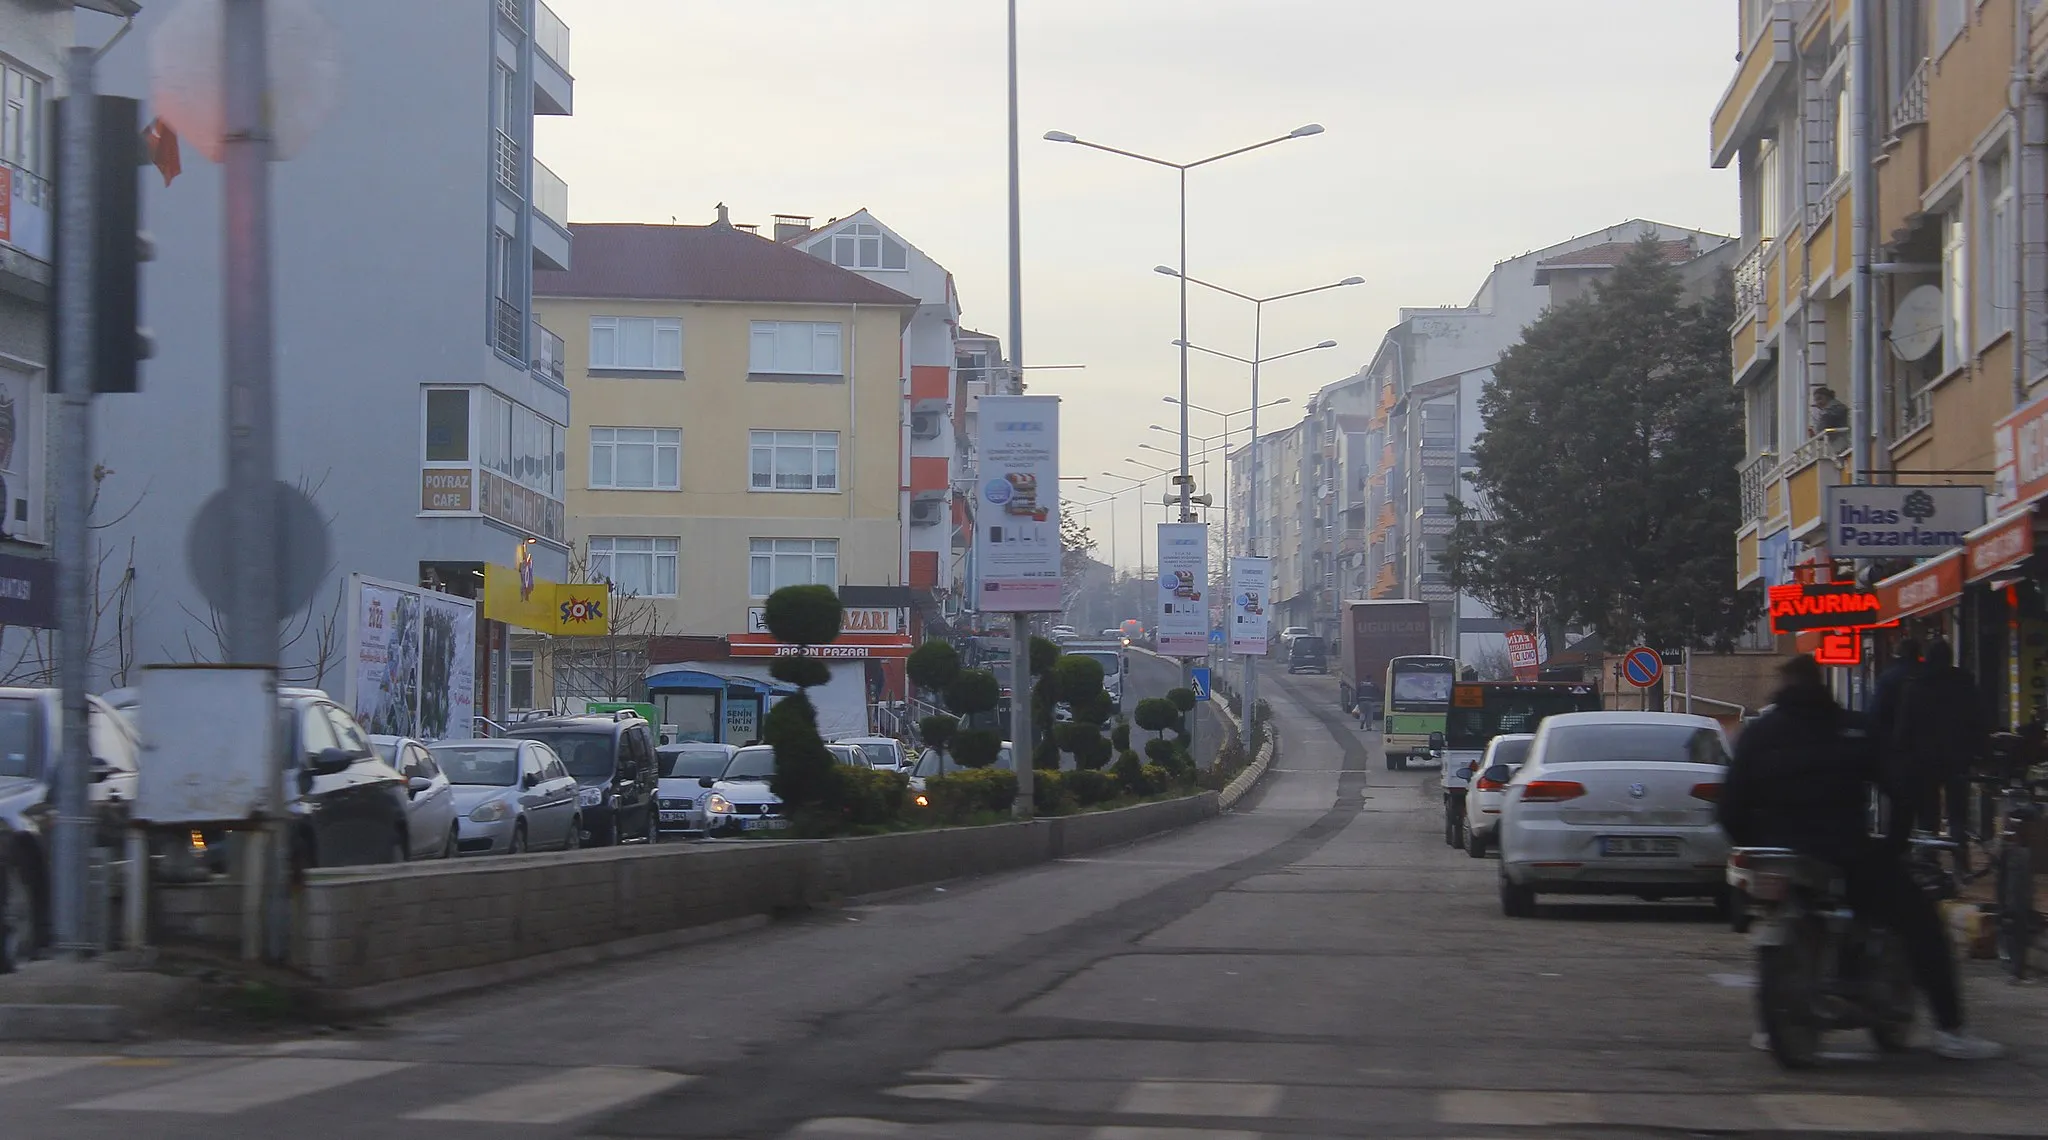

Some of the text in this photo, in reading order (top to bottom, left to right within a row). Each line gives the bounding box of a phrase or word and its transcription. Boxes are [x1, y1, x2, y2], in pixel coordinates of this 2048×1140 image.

[425, 475, 469, 489] POYRAZ
[433, 494, 461, 507] CAFE
[1839, 499, 1899, 525] İhlas
[560, 599, 603, 624] ŞOK
[823, 648, 868, 656] PAZARI
